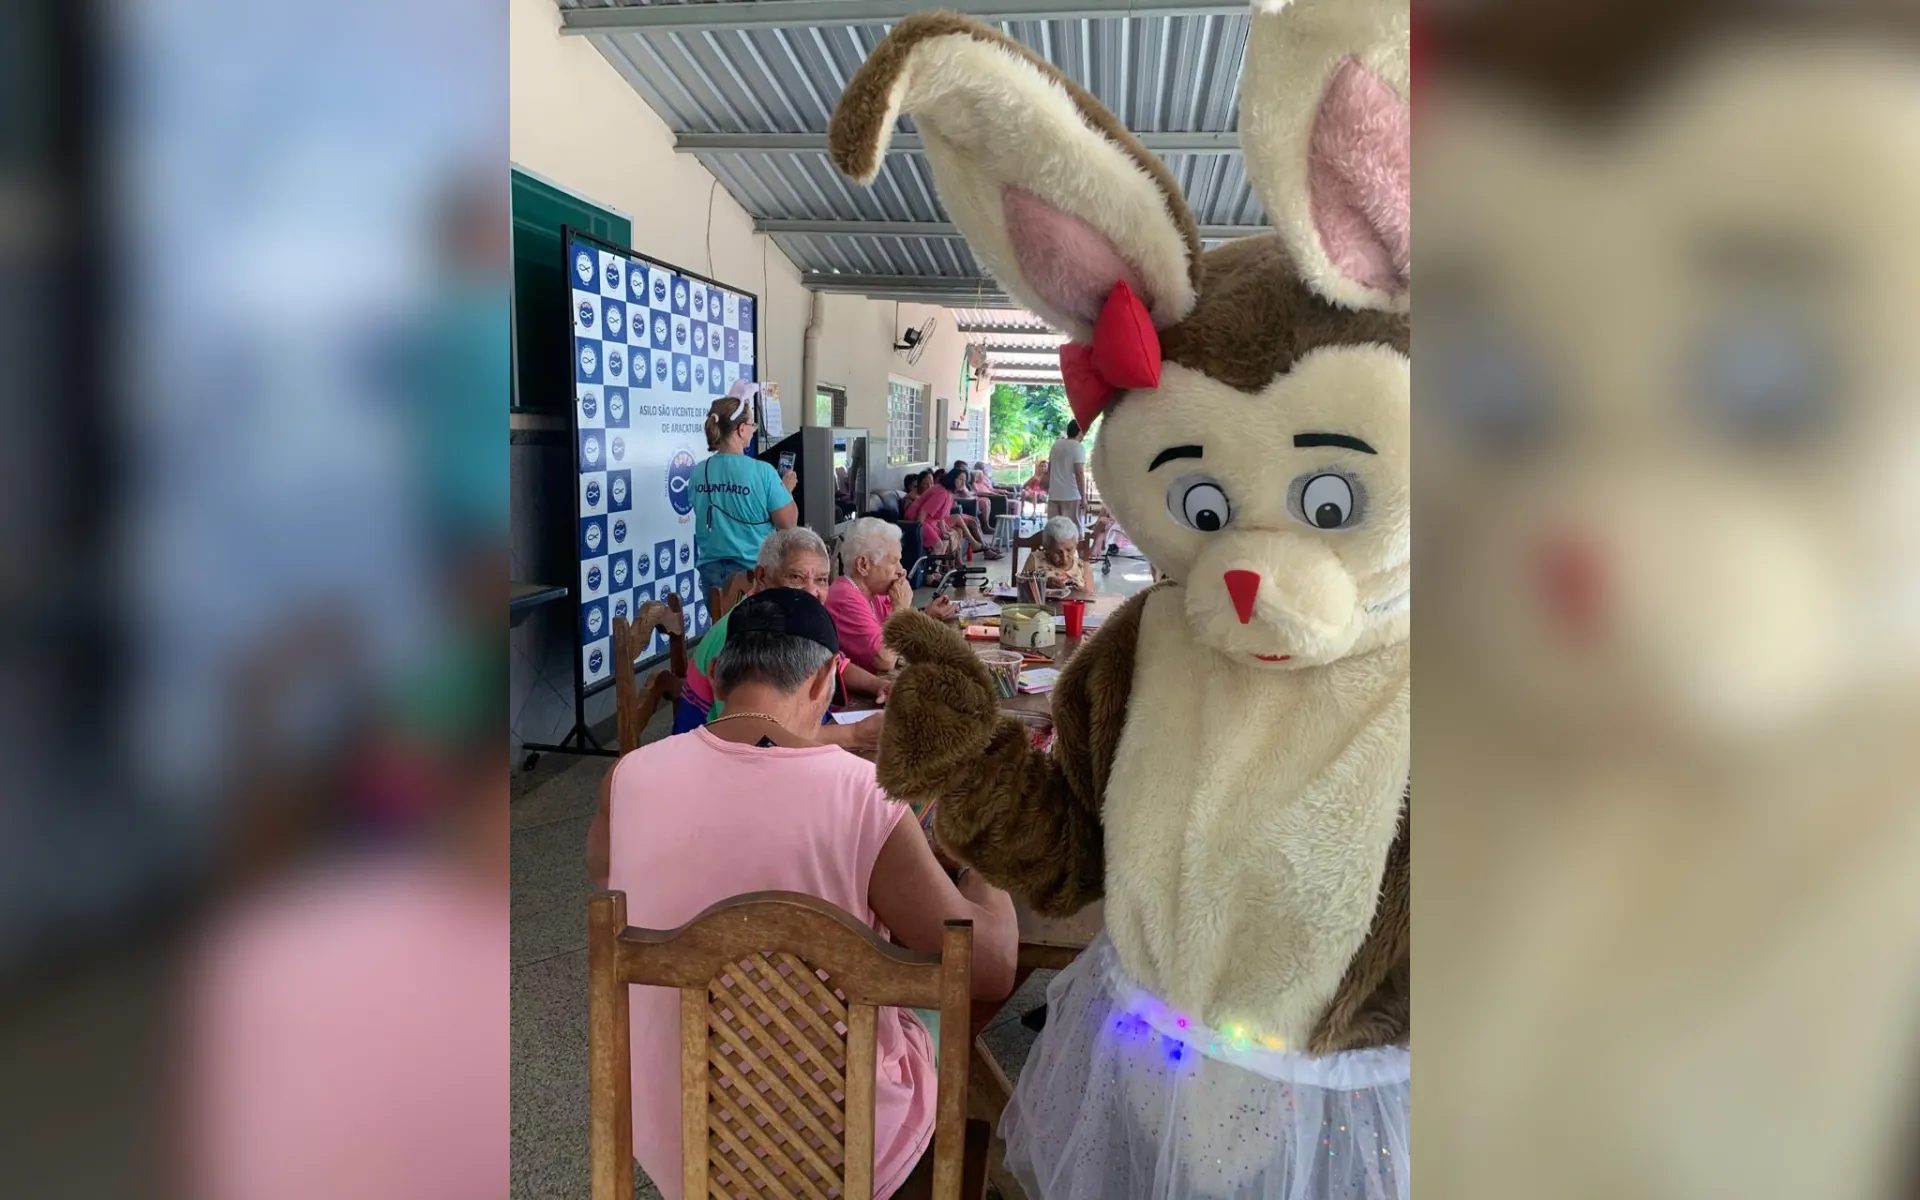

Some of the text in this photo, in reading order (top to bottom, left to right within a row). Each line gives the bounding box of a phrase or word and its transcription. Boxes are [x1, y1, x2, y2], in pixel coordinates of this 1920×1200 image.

[639, 405, 657, 416] ASILO
[658, 404, 671, 417] SÃO
[671, 406, 694, 417] VICENTE
[695, 407, 702, 417] DE
[662, 423, 670, 433] DE
